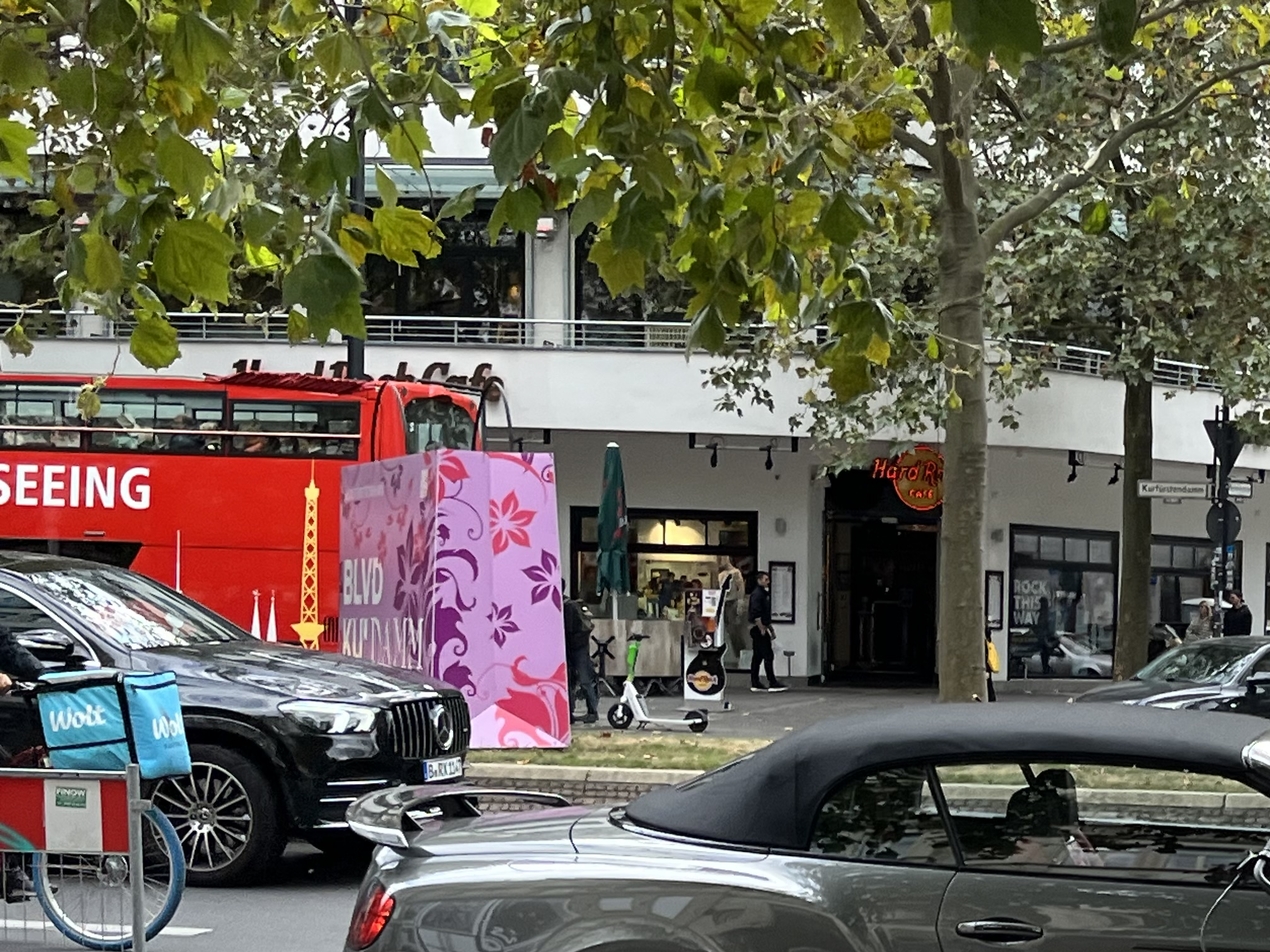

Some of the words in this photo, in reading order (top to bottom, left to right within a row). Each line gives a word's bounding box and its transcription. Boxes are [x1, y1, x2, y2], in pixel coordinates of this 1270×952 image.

[872, 458, 921, 481] Hard
[343, 557, 384, 606] BLVD
[1014, 579, 1048, 595] ROCK
[1013, 595, 1042, 610] THIS
[1013, 611, 1041, 625] WAY
[49, 704, 107, 732] Wolt
